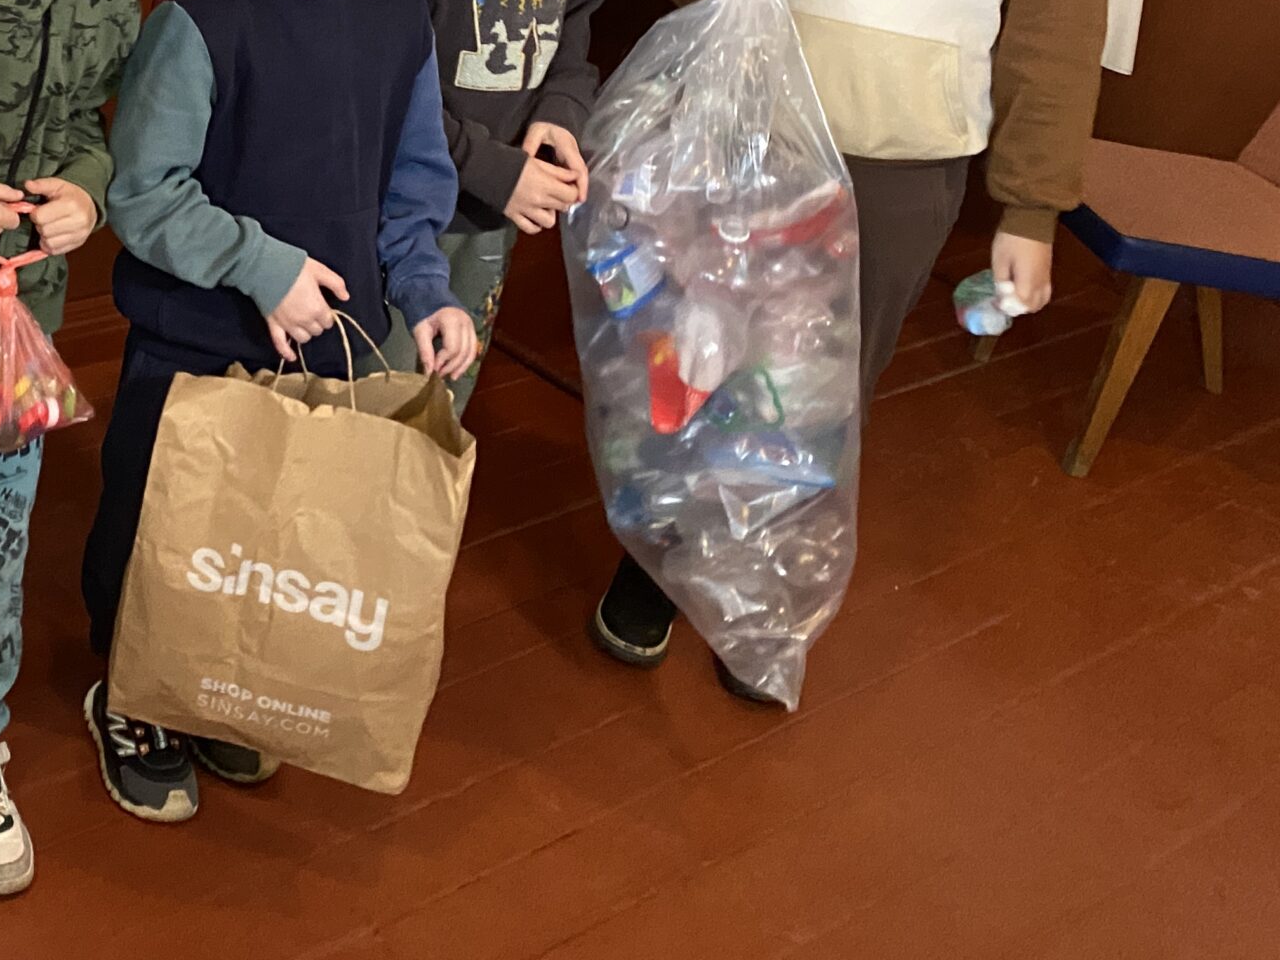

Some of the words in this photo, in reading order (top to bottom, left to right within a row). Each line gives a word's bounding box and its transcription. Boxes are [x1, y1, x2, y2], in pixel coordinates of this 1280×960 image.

[186, 542, 389, 652] sinsay
[196, 693, 331, 739] SINSAY.COM
[200, 677, 253, 701] SHOP
[256, 695, 333, 724] ONLINE
